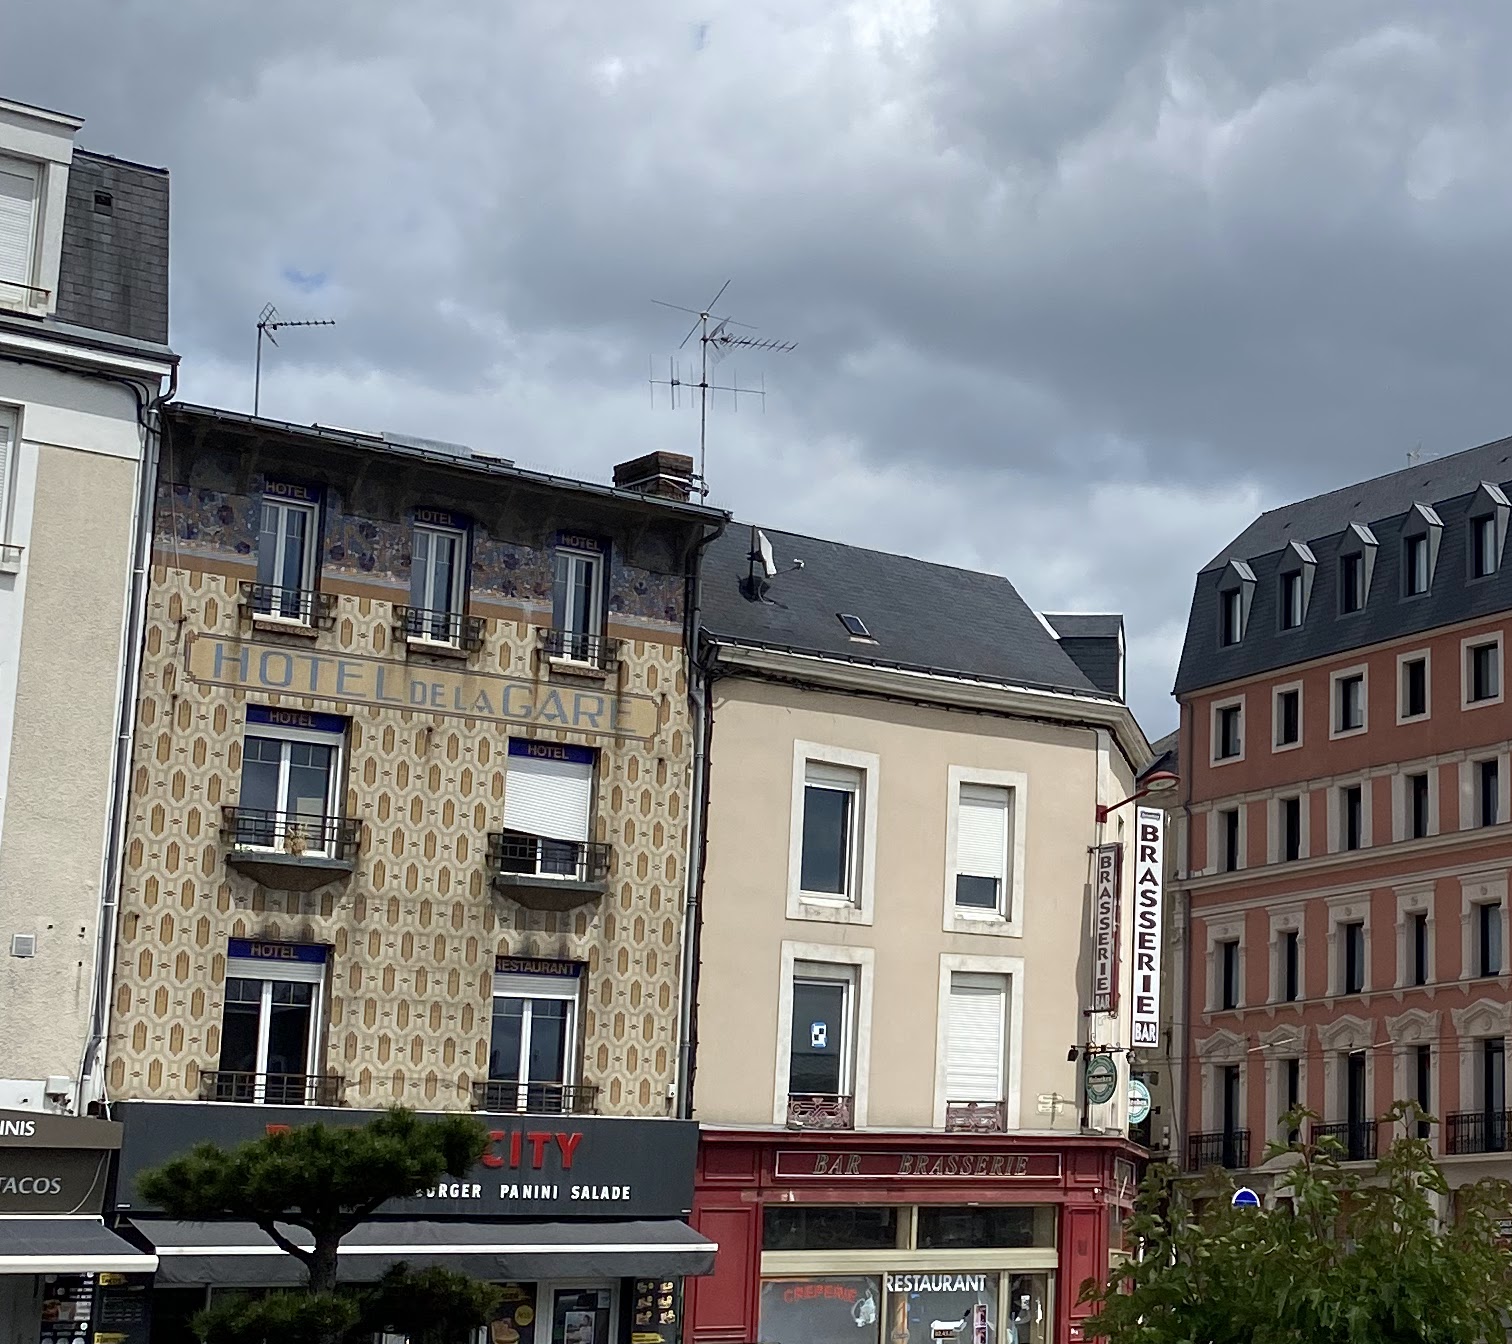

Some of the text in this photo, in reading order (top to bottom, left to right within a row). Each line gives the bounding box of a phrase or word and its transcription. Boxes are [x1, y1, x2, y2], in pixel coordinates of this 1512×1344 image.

[265, 480, 311, 500] HOTEL
[561, 534, 601, 552] HOTEL
[213, 643, 637, 734] HOTEL DE LA GARE
[269, 711, 317, 729] HOTEL
[527, 743, 571, 761] HOTEL
[1096, 855, 1113, 992] BRASSERIE
[1136, 823, 1160, 1015] BRASSERIE
[250, 943, 298, 959] HOTEL
[1134, 1021, 1157, 1043] BAR
[482, 1129, 584, 1169] CITY
[813, 1153, 1029, 1176] BAR BRASSERIE
[500, 1184, 558, 1200] PANINI
[570, 1185, 632, 1201] SALADE
[887, 1274, 987, 1293] RESTAURANT
